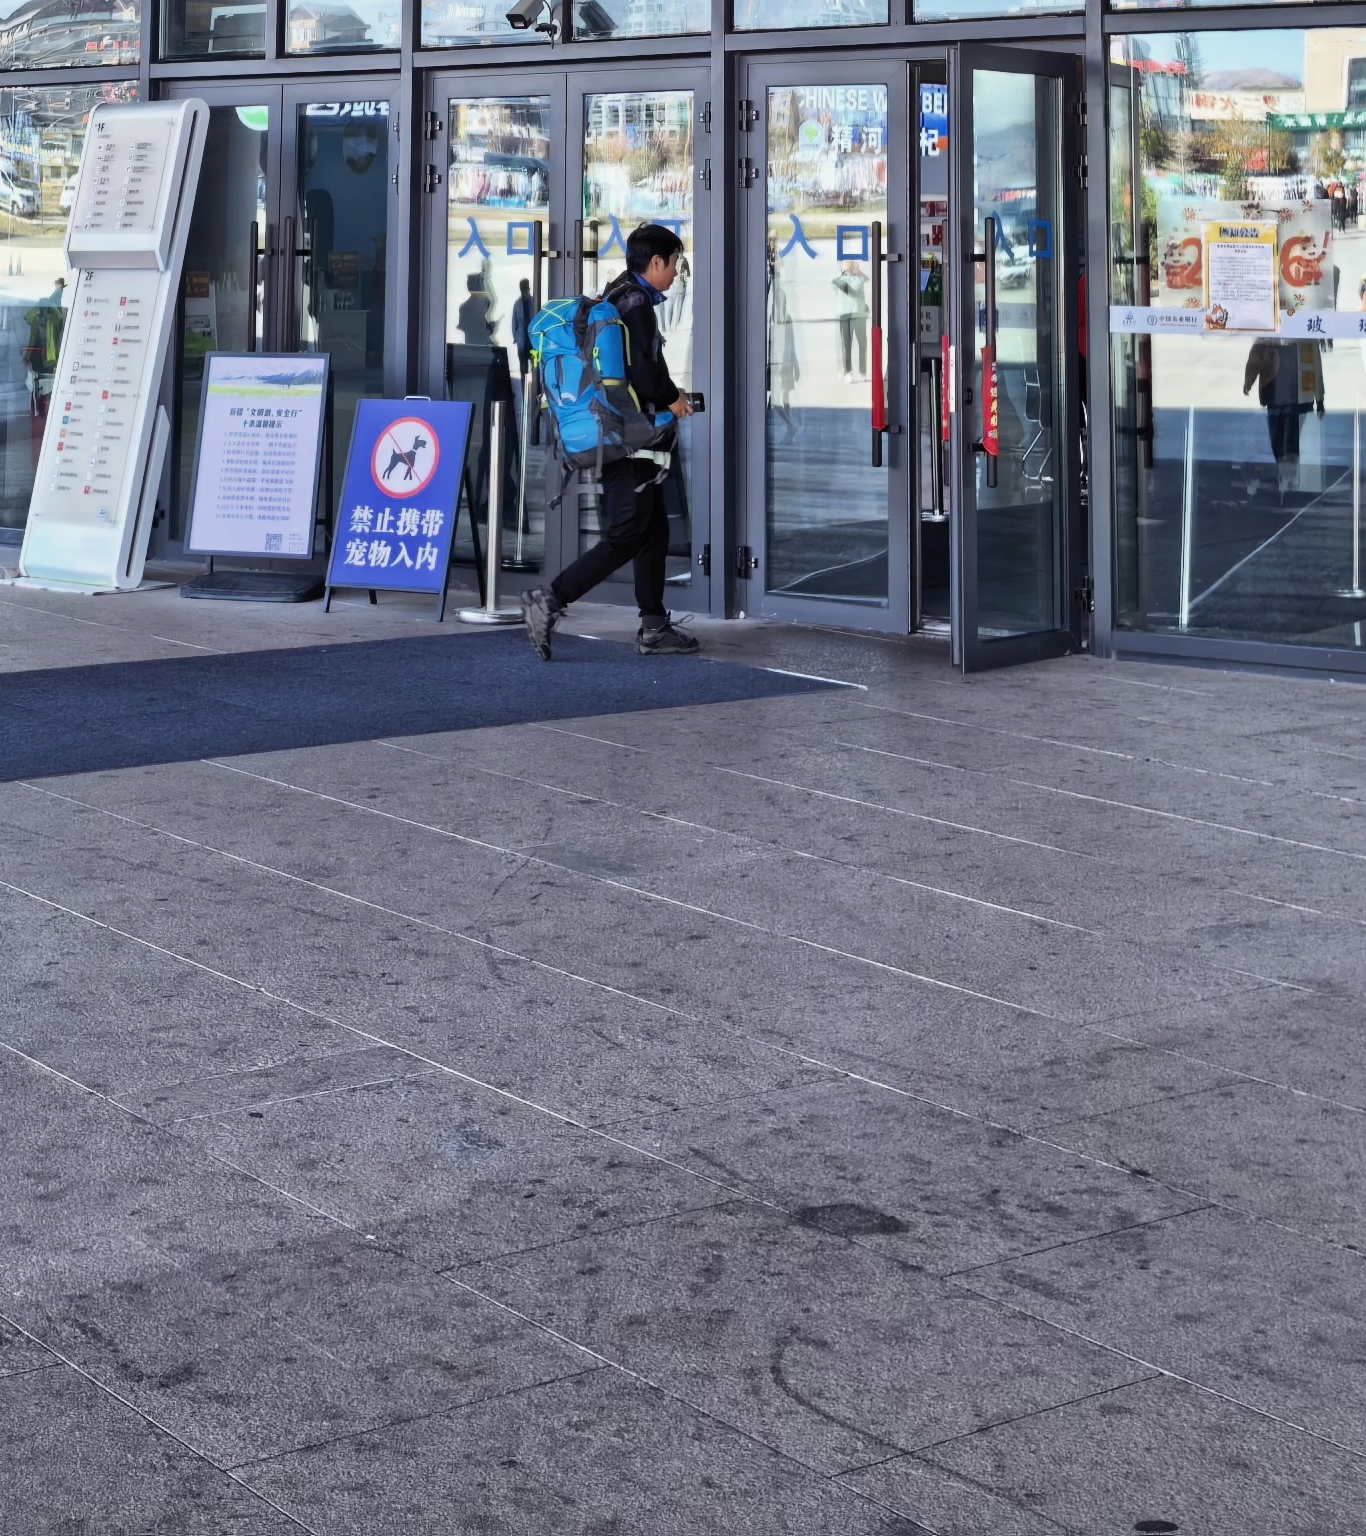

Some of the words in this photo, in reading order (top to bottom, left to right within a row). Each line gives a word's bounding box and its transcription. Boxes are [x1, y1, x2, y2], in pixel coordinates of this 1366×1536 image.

[458, 216, 534, 259] 入口
[779, 214, 869, 261] 入口
[349, 505, 444, 538] 禁止携带
[343, 538, 439, 571] 宠物入内
